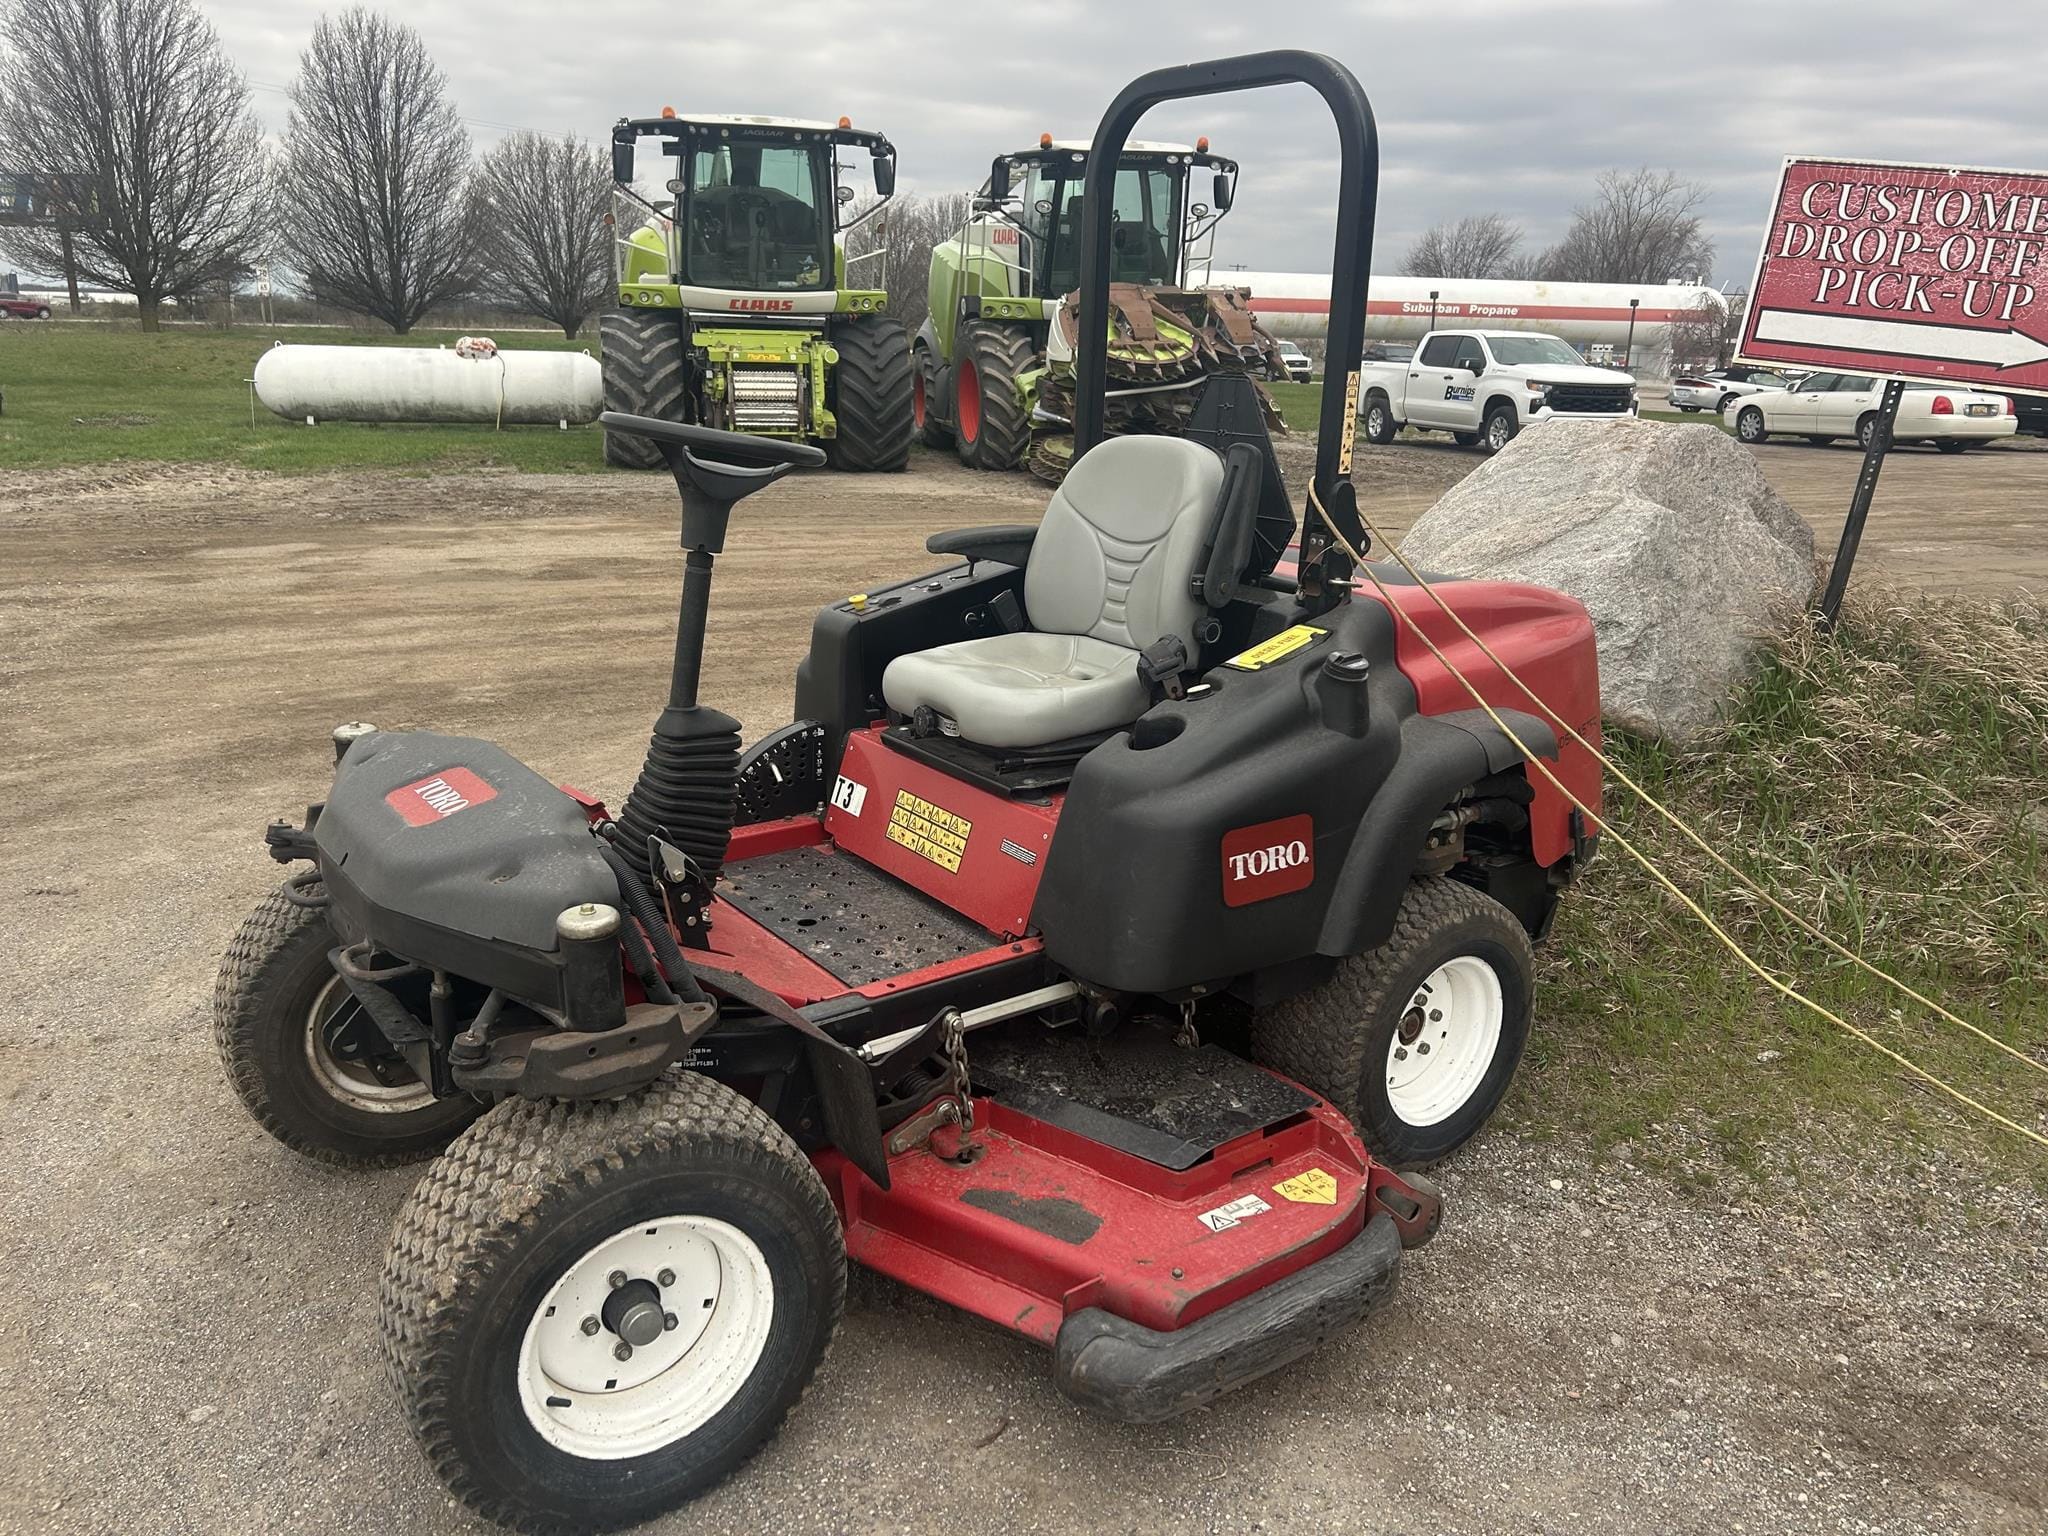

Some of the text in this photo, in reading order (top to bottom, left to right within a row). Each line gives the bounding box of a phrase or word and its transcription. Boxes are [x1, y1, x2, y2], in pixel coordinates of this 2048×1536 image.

[1120, 153, 1153, 161] AGUAR
[1776, 221, 2045, 278] DROP-OFF
[729, 298, 794, 311] CLAAS
[1812, 266, 2036, 322] PICK-UP
[1468, 304, 1519, 317] Propane
[1444, 384, 1476, 401] Burnips
[1250, 633, 1301, 659] DIESEL FUEL
[413, 777, 470, 817] TORO
[1228, 840, 1310, 881] TORO
